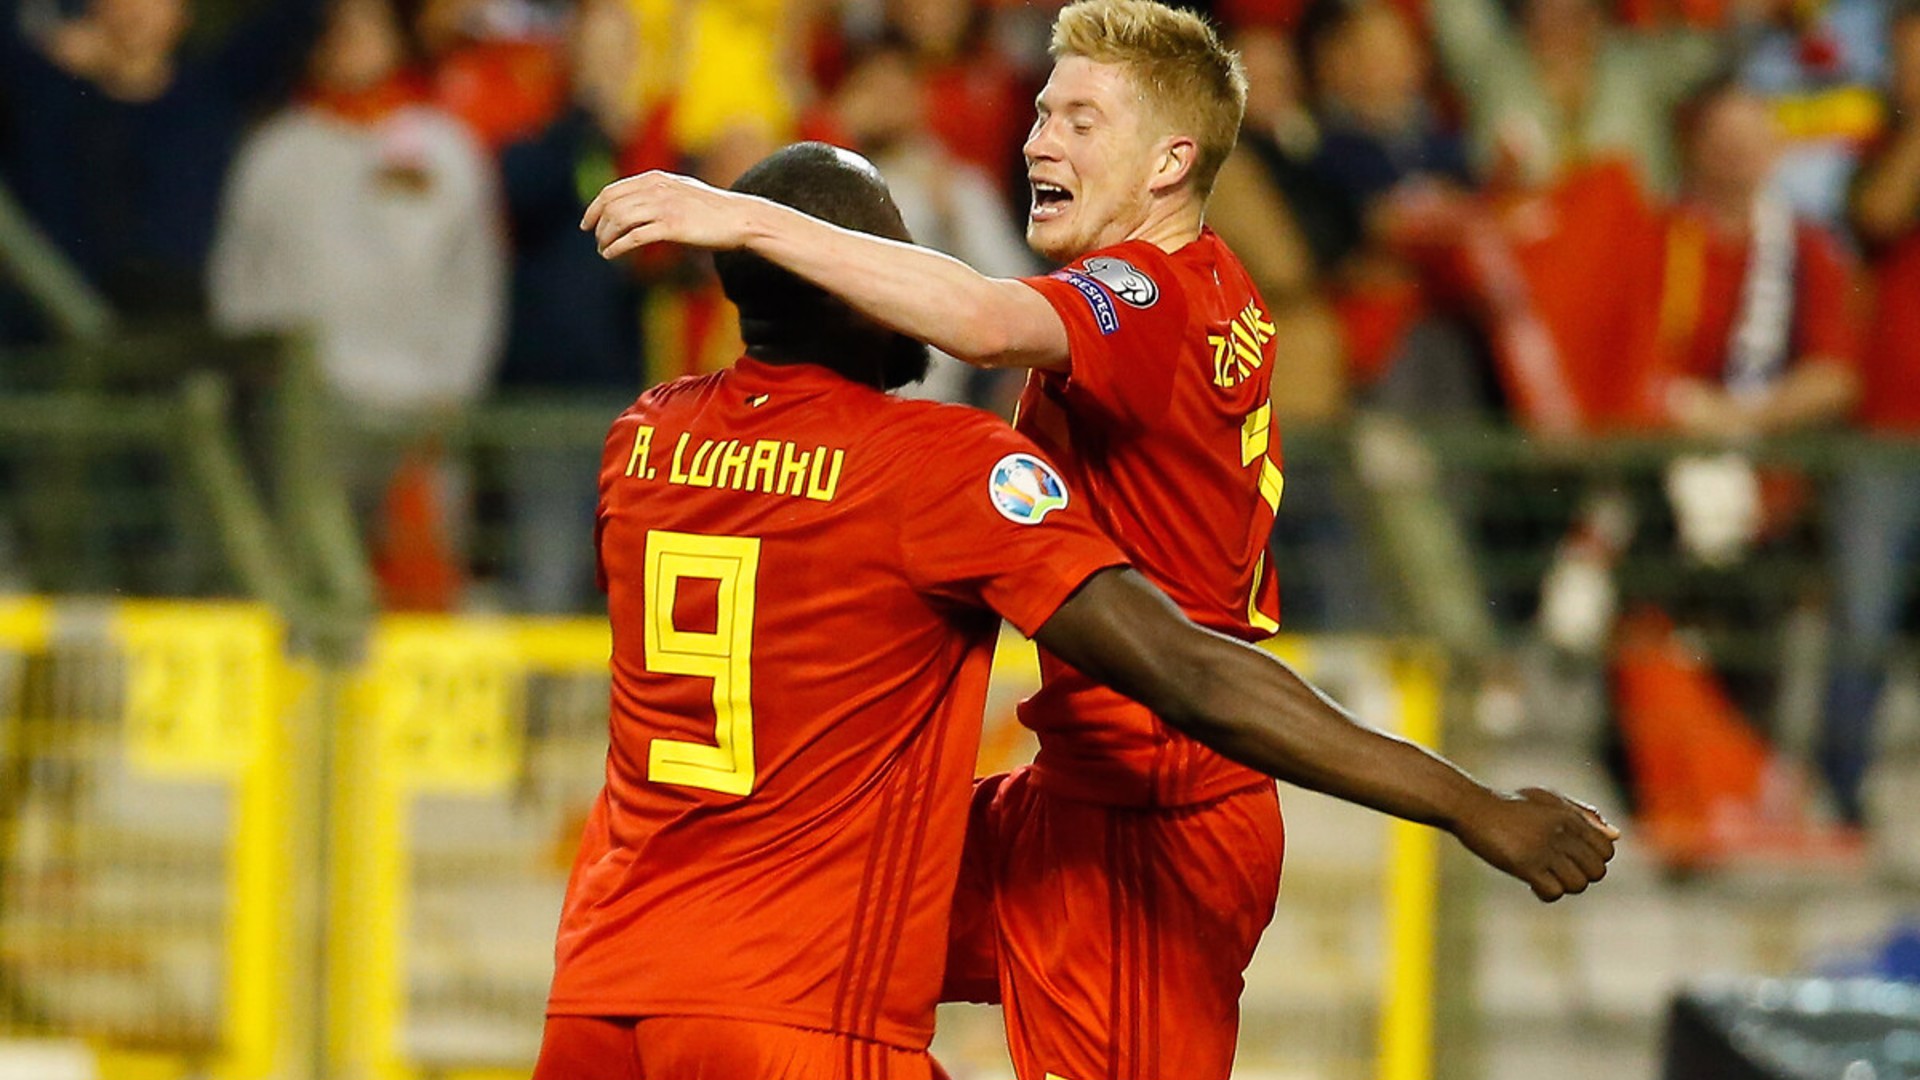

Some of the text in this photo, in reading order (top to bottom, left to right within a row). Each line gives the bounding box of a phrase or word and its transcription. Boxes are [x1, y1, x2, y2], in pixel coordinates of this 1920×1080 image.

[1068, 277, 1115, 331] RESPECT
[668, 431, 845, 502] LUKAKU
[643, 529, 761, 796] 9
